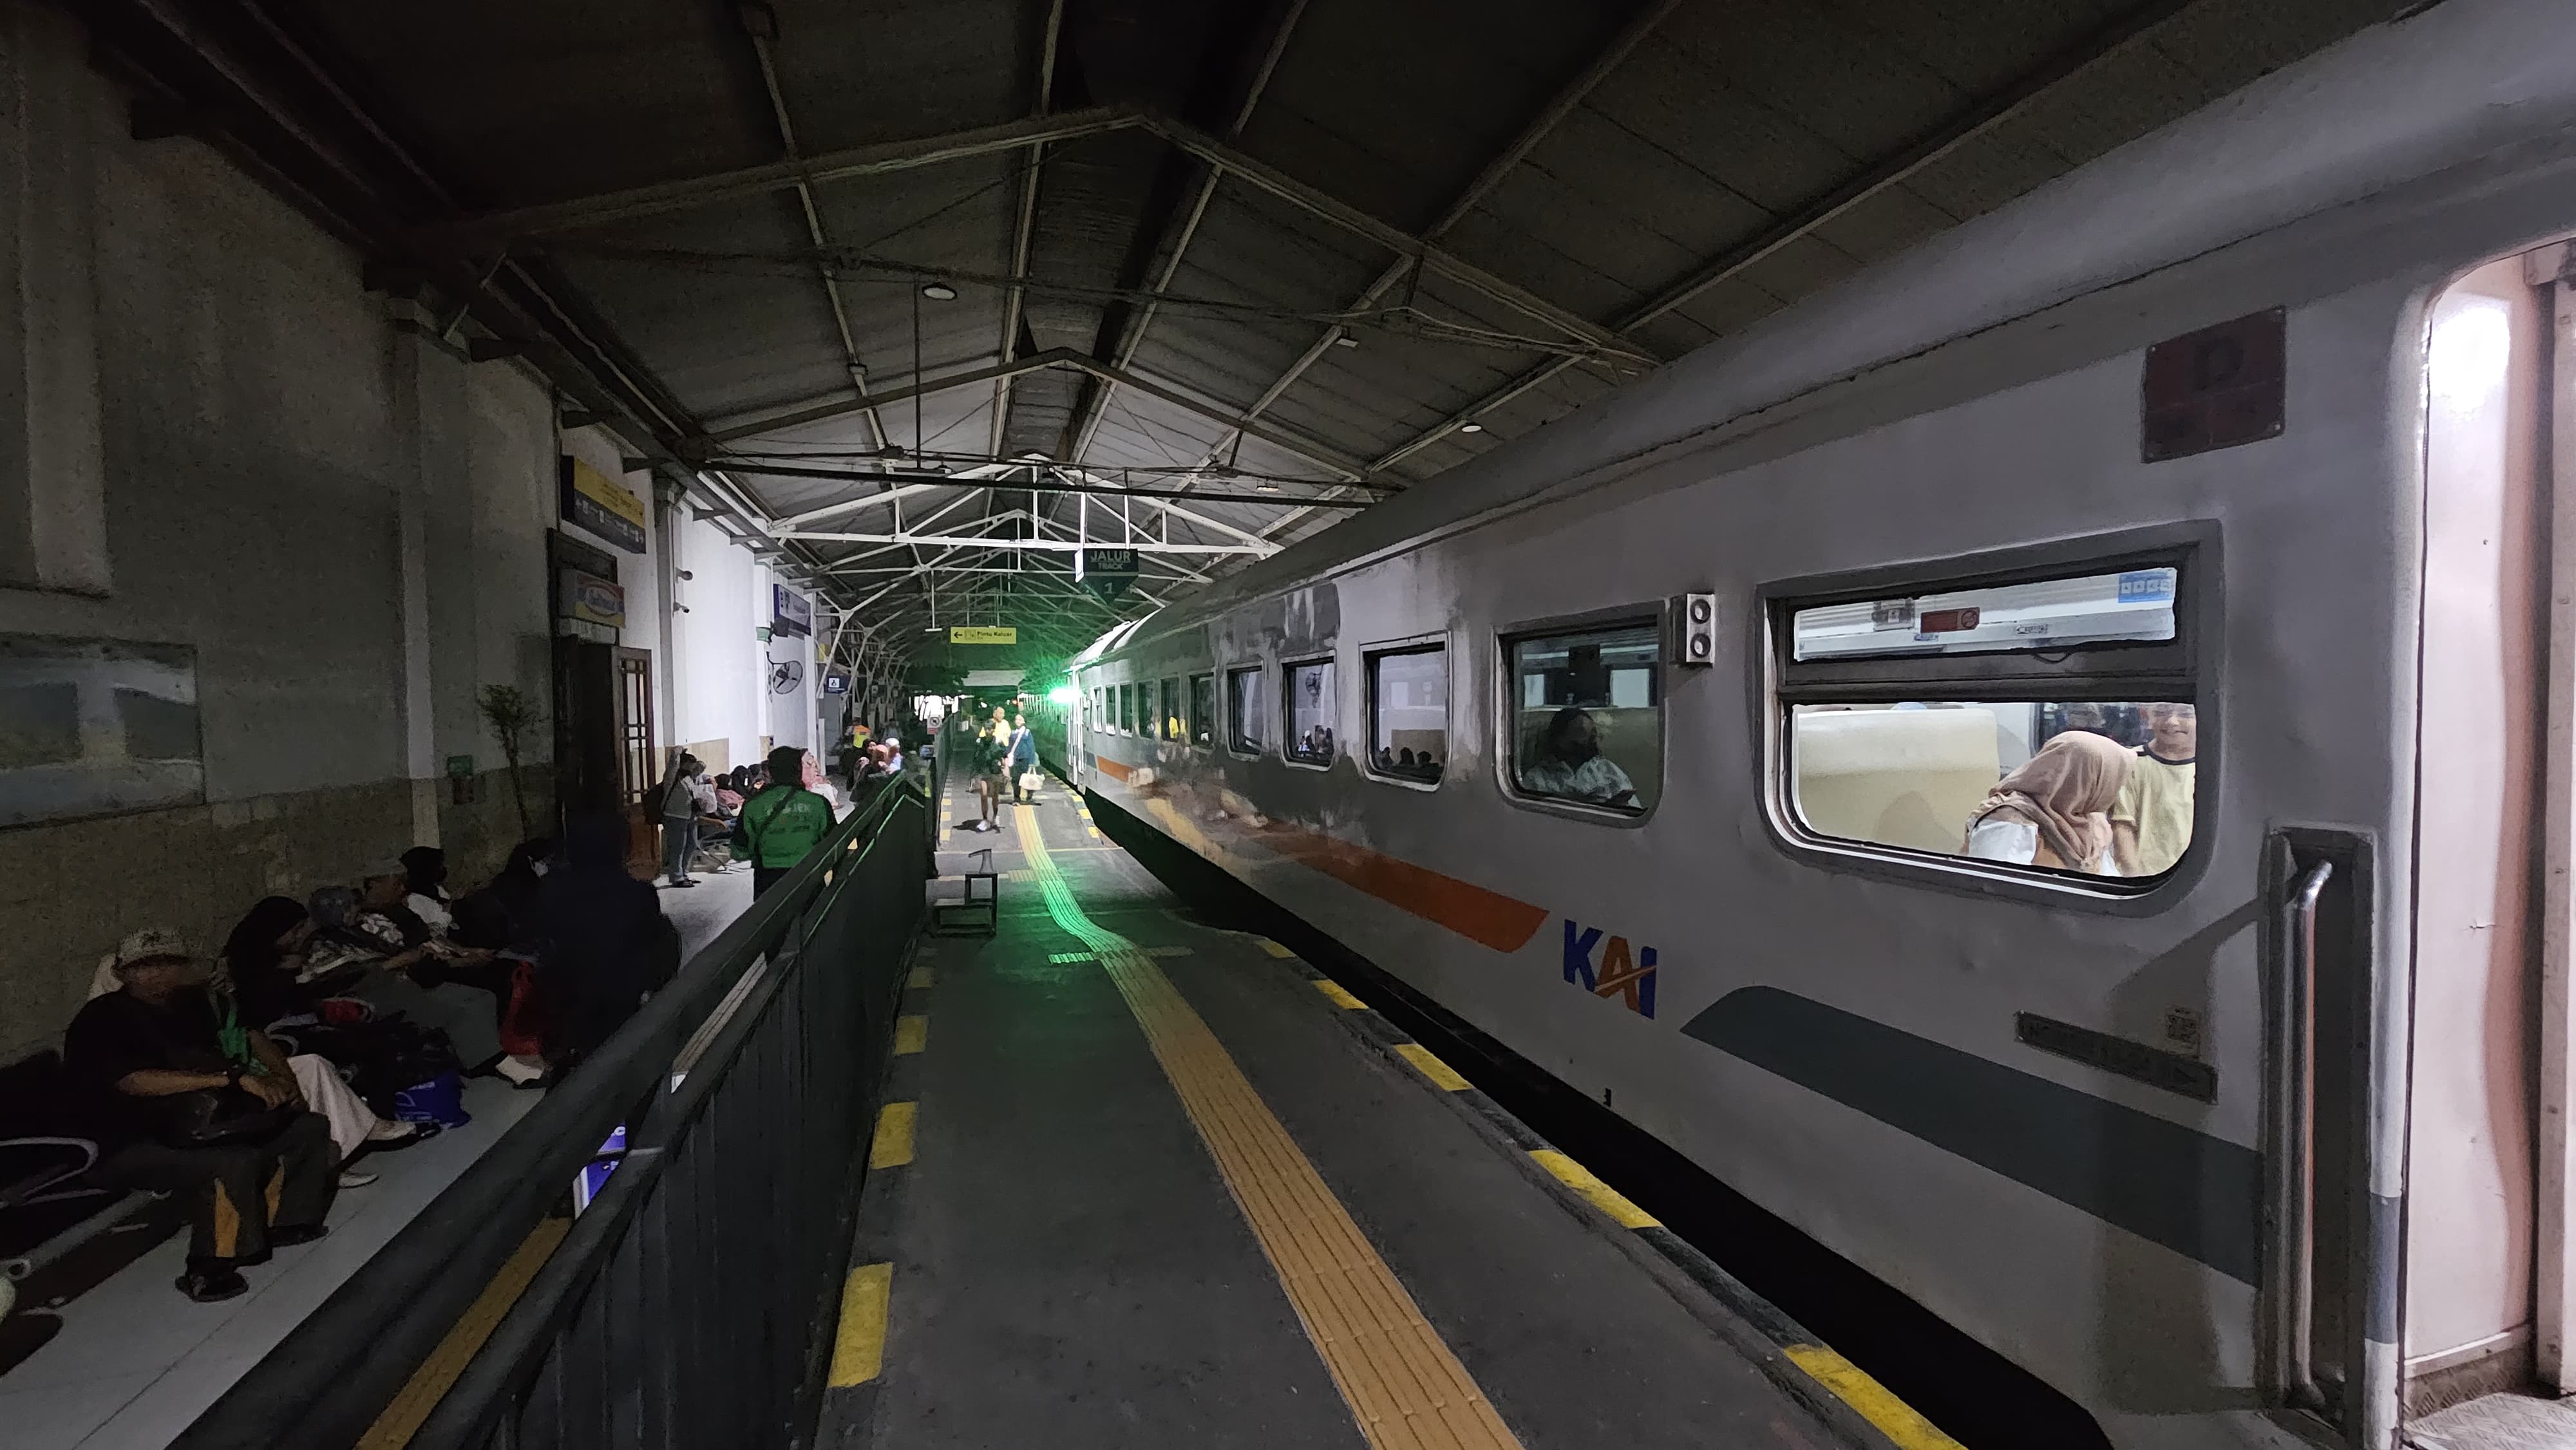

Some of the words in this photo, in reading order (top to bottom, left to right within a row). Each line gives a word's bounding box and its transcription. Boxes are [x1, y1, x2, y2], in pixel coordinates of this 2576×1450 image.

[1090, 551, 1130, 562] JALUR
[1104, 582, 1113, 594] 1
[1564, 919, 1657, 1020] KAI
